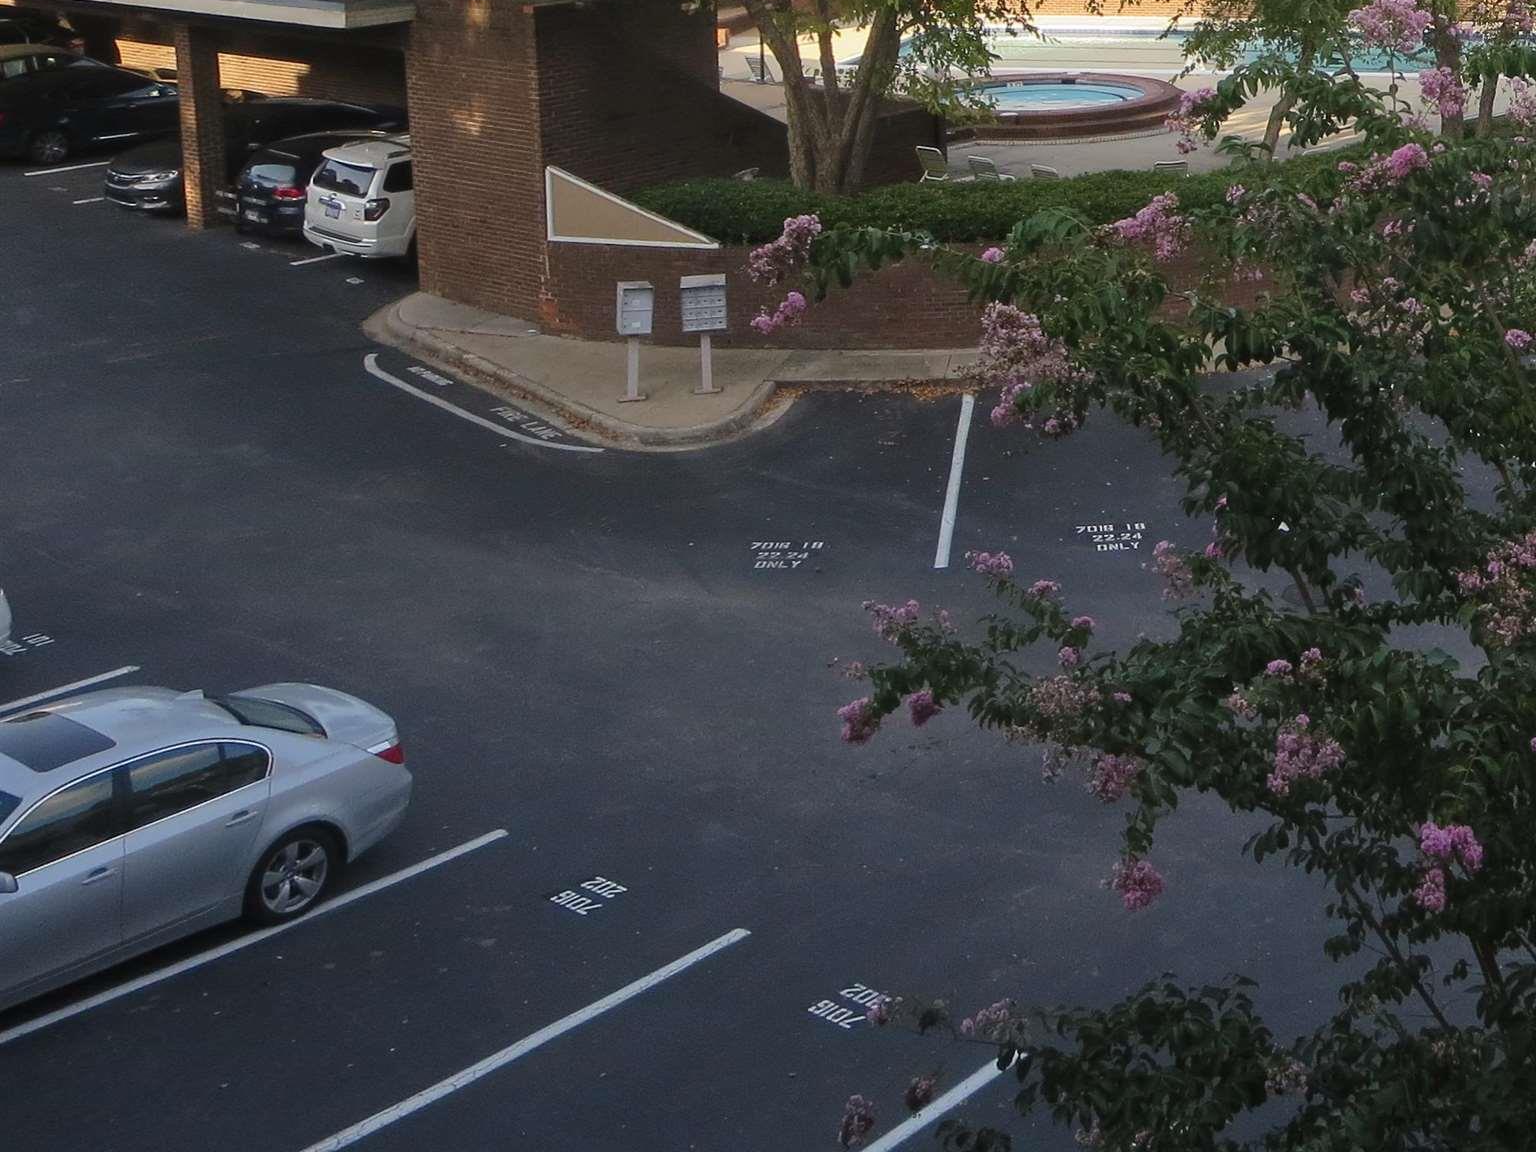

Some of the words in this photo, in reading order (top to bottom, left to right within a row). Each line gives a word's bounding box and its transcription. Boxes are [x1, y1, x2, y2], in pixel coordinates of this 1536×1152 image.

[1096, 541, 1140, 552] ONLY
[754, 560, 802, 569] ONLY
[580, 876, 628, 899] 202
[549, 890, 603, 915] 7016
[807, 999, 867, 1029] 7016
